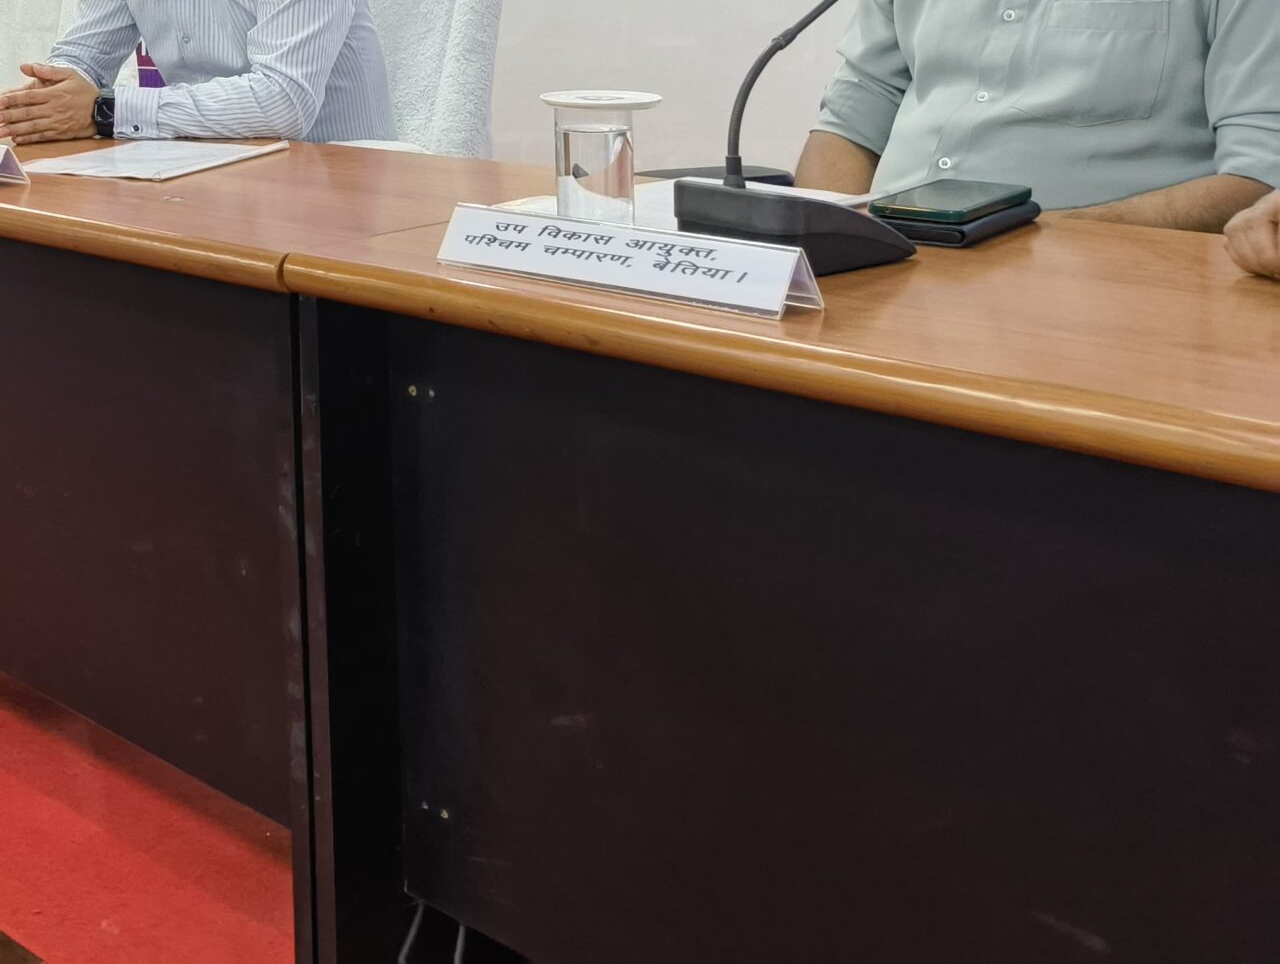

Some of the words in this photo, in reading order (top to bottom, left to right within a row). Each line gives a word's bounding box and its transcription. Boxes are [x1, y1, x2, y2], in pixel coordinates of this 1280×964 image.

[463, 233, 533, 253] पश्चिम
[543, 245, 636, 269] चम्पारण,
[494, 221, 529, 235] उप
[537, 223, 615, 247] विकास
[625, 238, 721, 262] आयुक्त,
